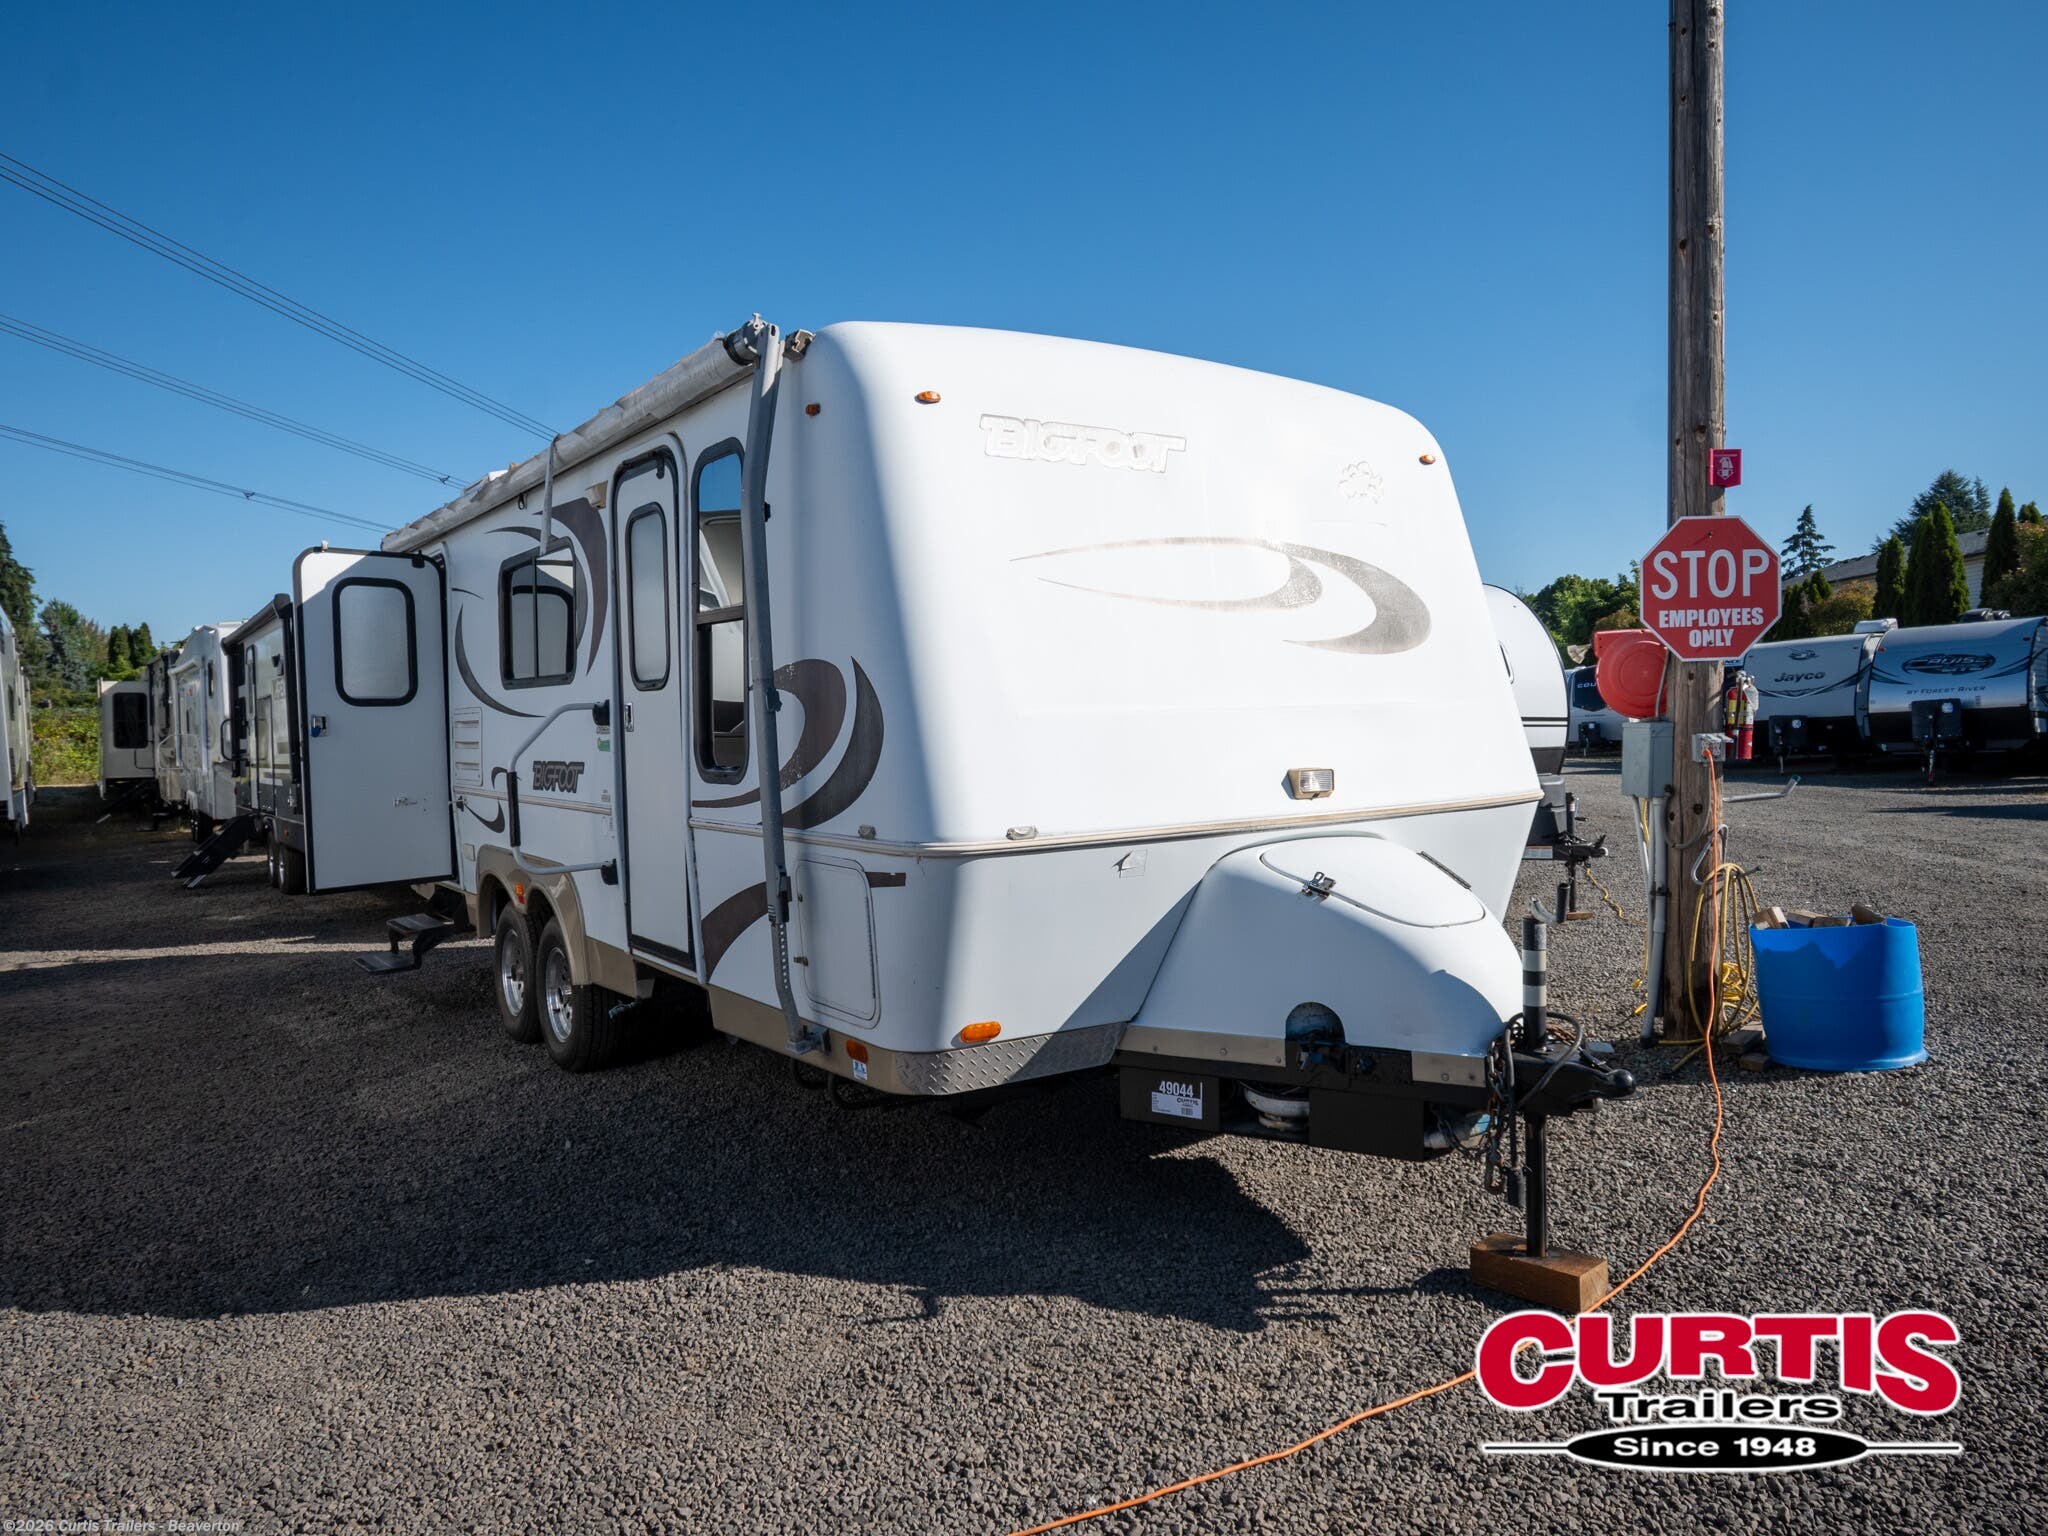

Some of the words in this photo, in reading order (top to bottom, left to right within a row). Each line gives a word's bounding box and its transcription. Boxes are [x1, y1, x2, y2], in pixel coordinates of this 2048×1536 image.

[980, 413, 1186, 473] BIGFOOT
[1652, 549, 1770, 600] STOP
[1658, 608, 1764, 629] EMPLOYEES
[1689, 629, 1735, 648] ONLY
[1774, 671, 1826, 683] Jayco
[532, 760, 585, 793] BIGFOOT
[1159, 1080, 1194, 1098] 49044
